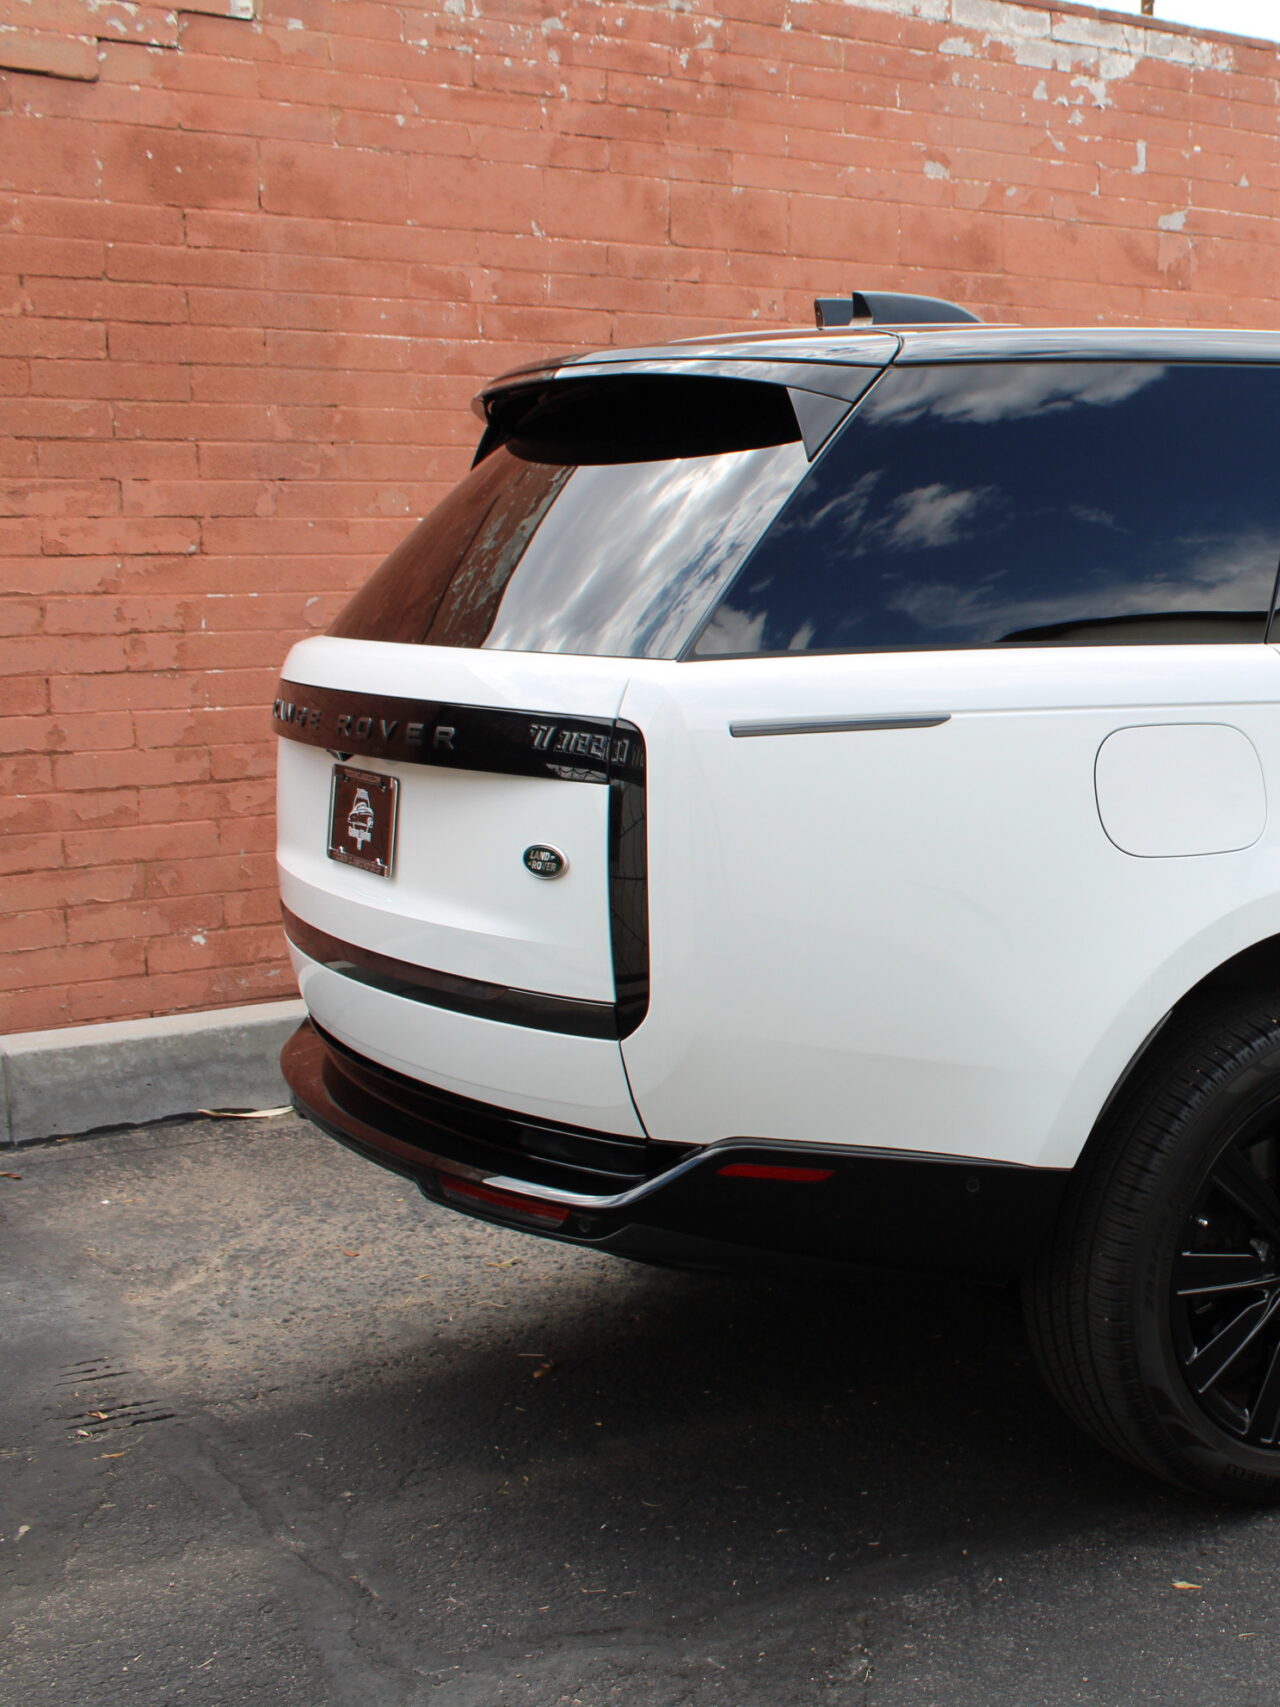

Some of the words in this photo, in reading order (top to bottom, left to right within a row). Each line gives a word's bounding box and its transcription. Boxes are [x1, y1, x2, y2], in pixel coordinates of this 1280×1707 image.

[336, 714, 457, 749] ROVER
[530, 850, 551, 861] LAND
[531, 860, 557, 872] ROVER
